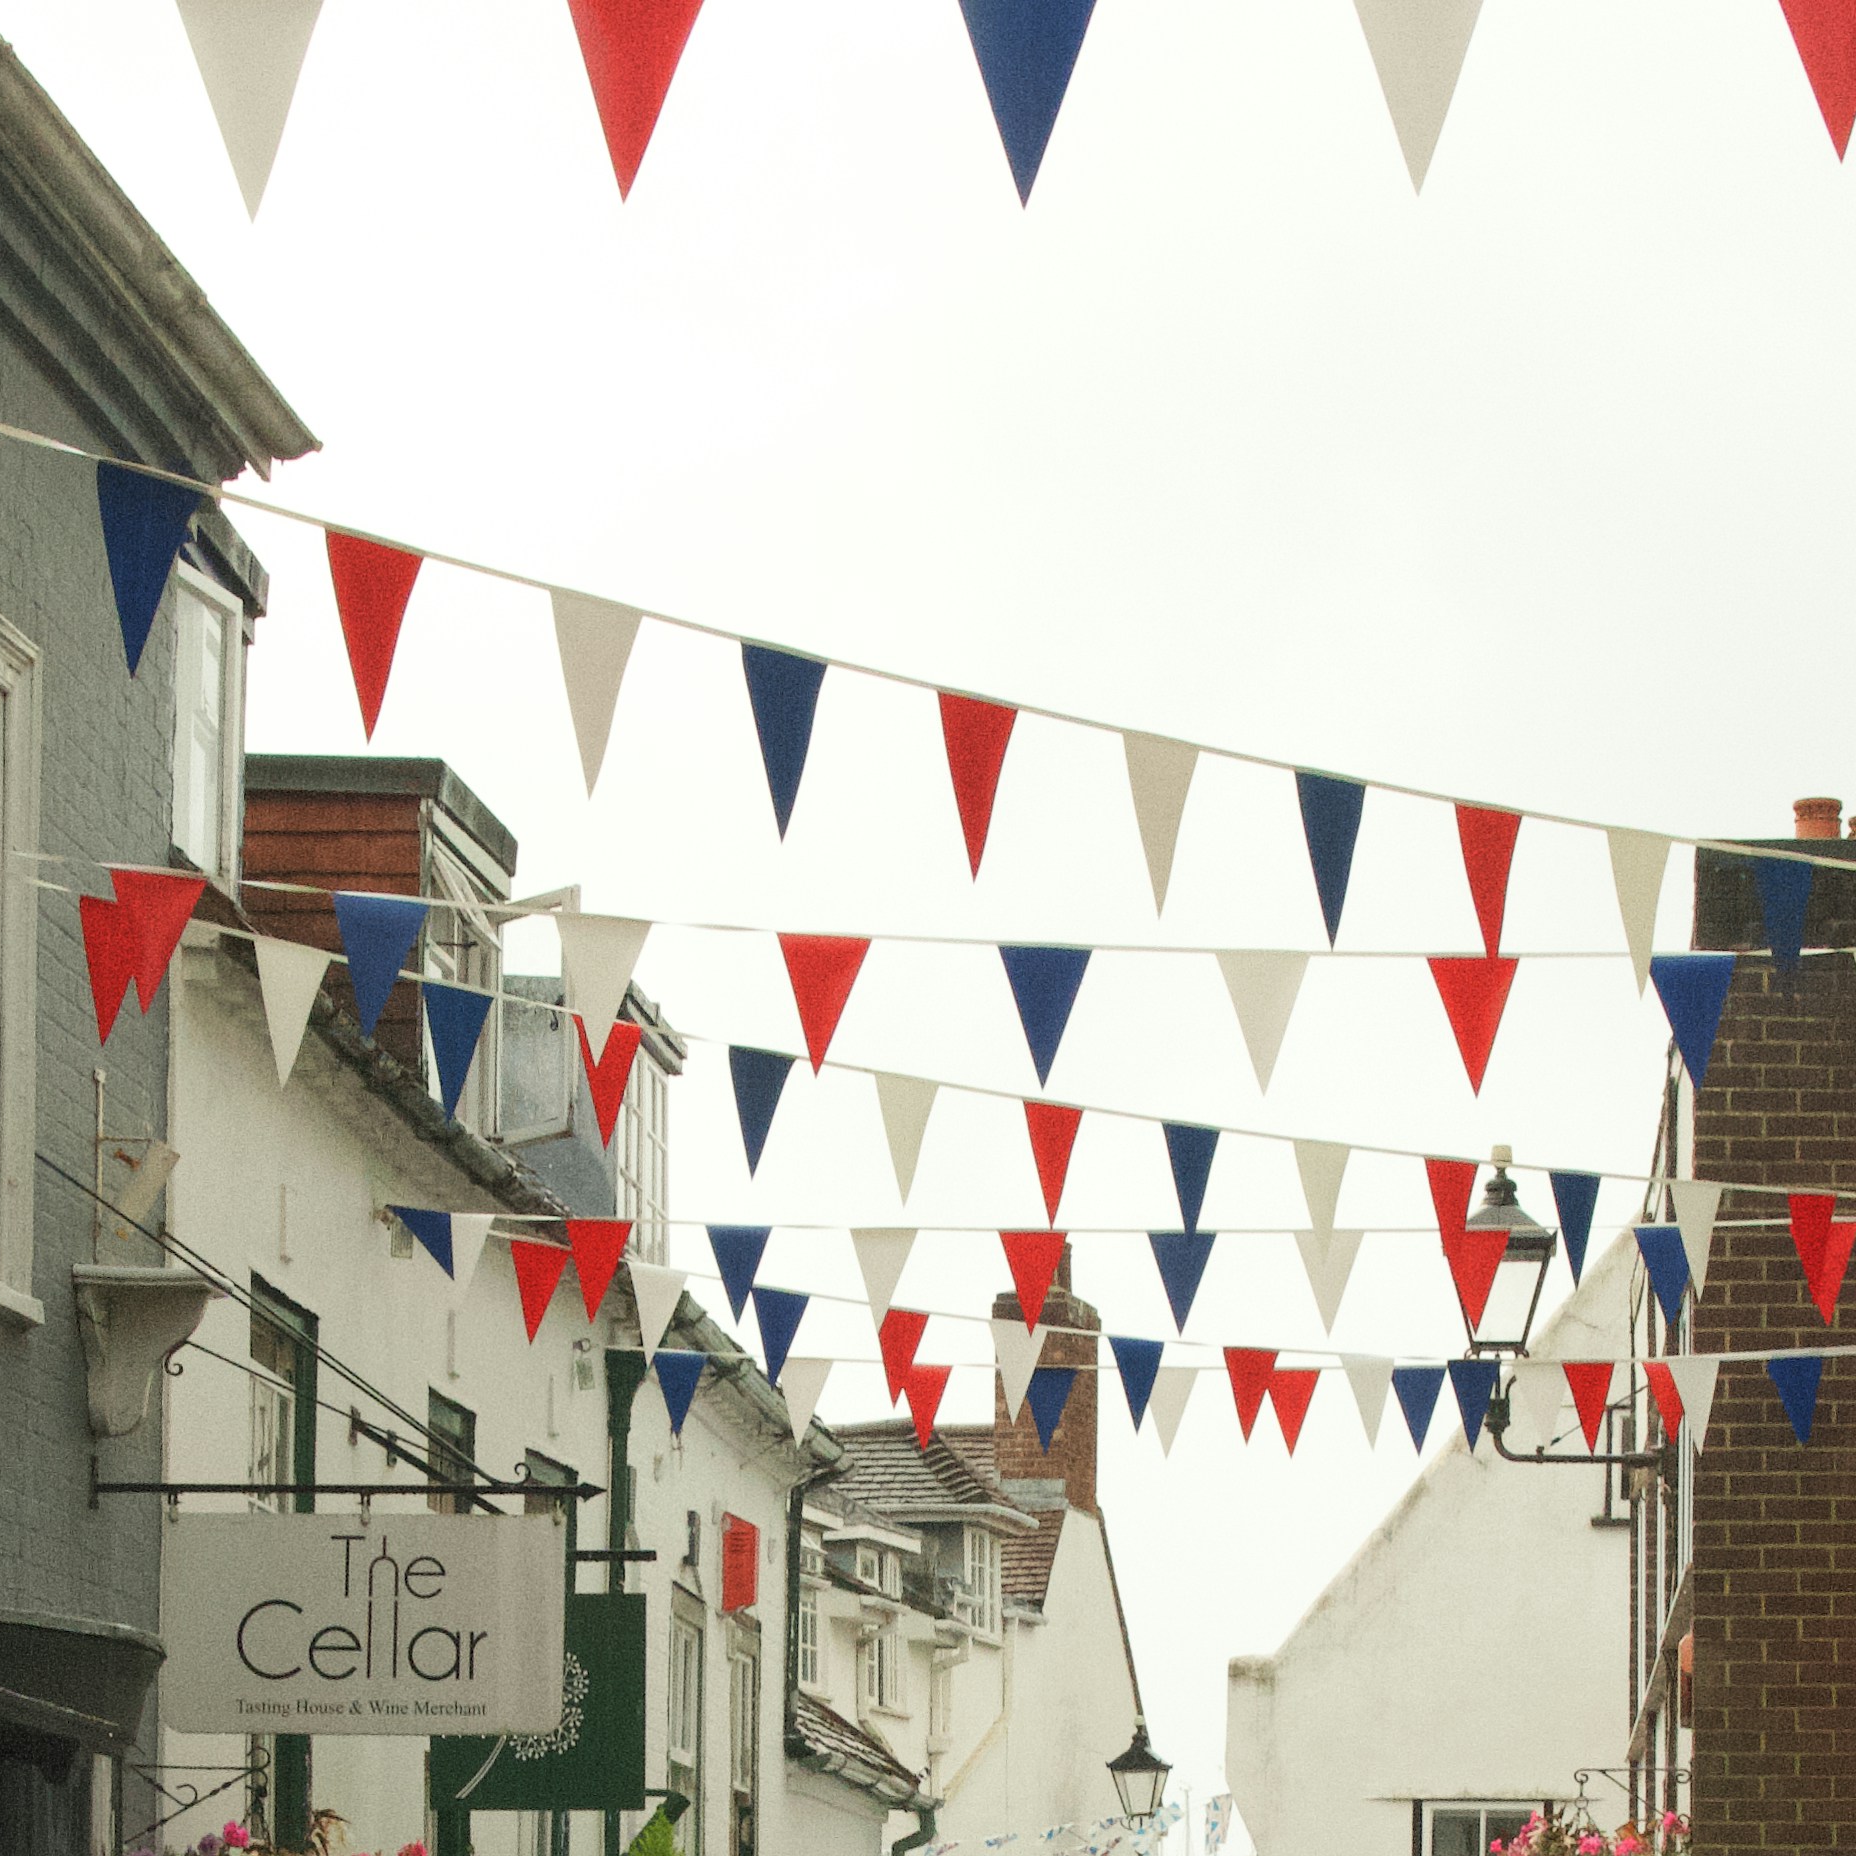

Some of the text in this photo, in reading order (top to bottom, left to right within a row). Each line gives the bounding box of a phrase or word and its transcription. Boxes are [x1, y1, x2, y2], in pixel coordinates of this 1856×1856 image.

[330, 1535, 446, 1599] The
[236, 1599, 487, 1681] Cellar
[235, 1698, 487, 1718] Tasting House & Wine Merchant
